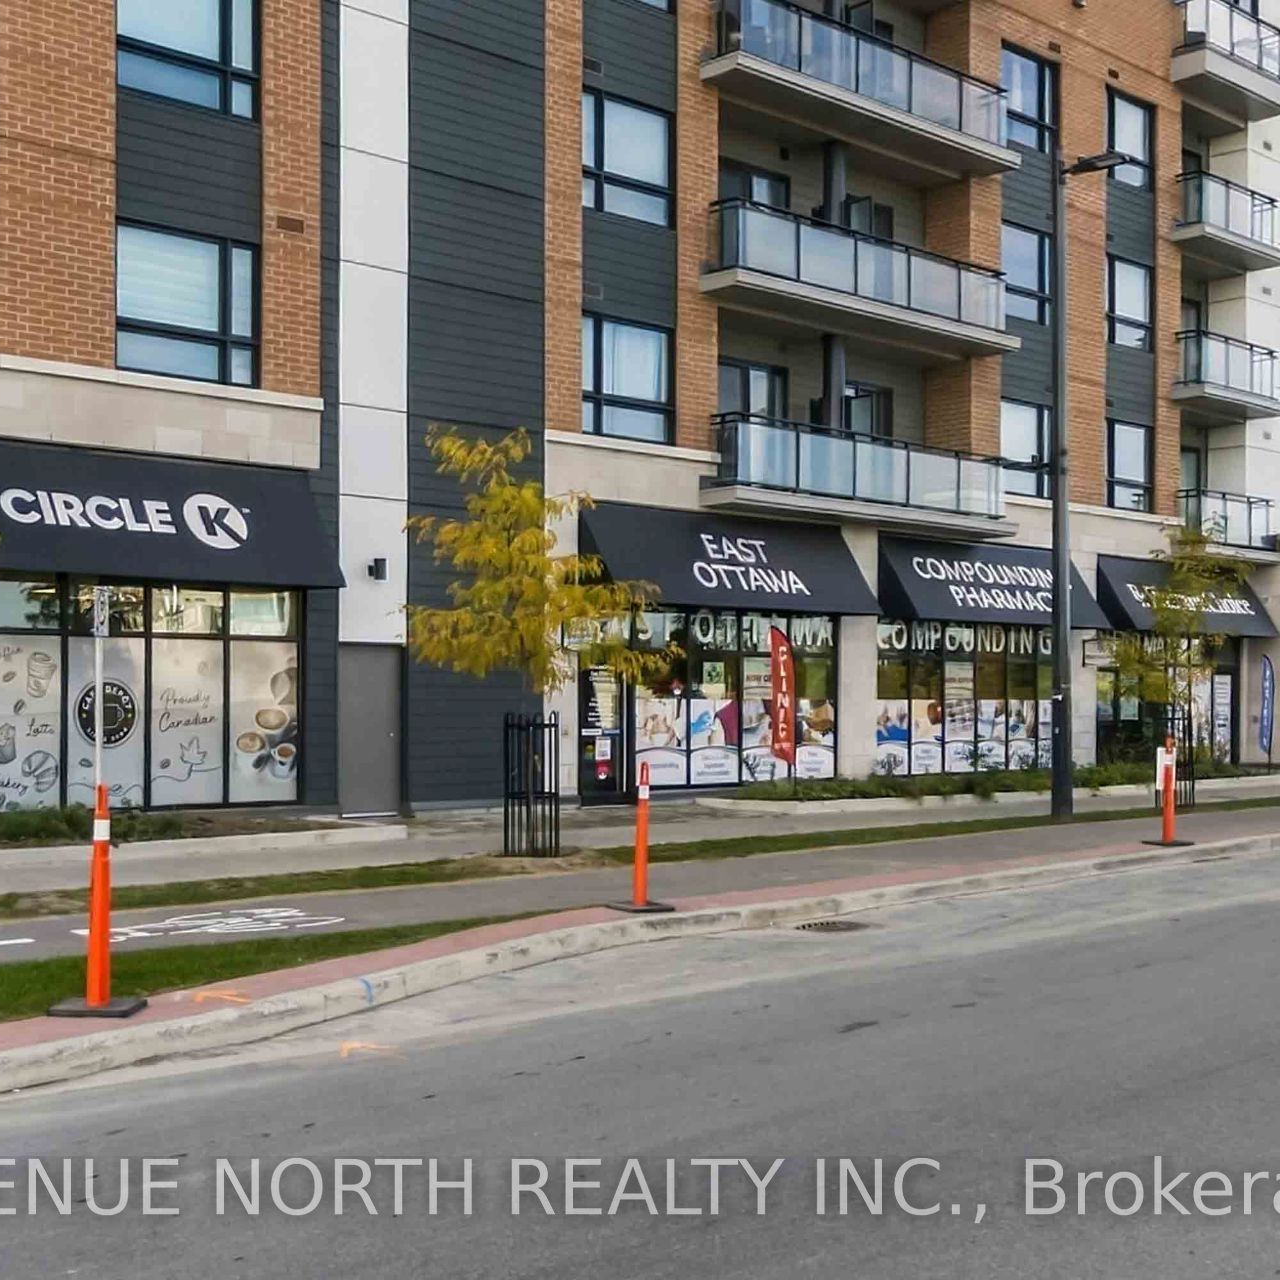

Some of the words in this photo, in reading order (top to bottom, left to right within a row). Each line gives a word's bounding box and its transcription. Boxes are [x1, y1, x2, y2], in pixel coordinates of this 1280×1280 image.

[0, 488, 177, 534] CIRCLE
[194, 501, 248, 545] K
[700, 533, 768, 564] EAST
[692, 561, 811, 595] OTTAWA
[912, 556, 1072, 589] COMPOUNDIN
[948, 584, 1053, 612] PHARMAC
[876, 620, 1052, 655] COMPOUNDING
[159, 687, 210, 709] Proudly
[776, 646, 790, 738] CLINIC
[158, 711, 217, 732] Canadian
